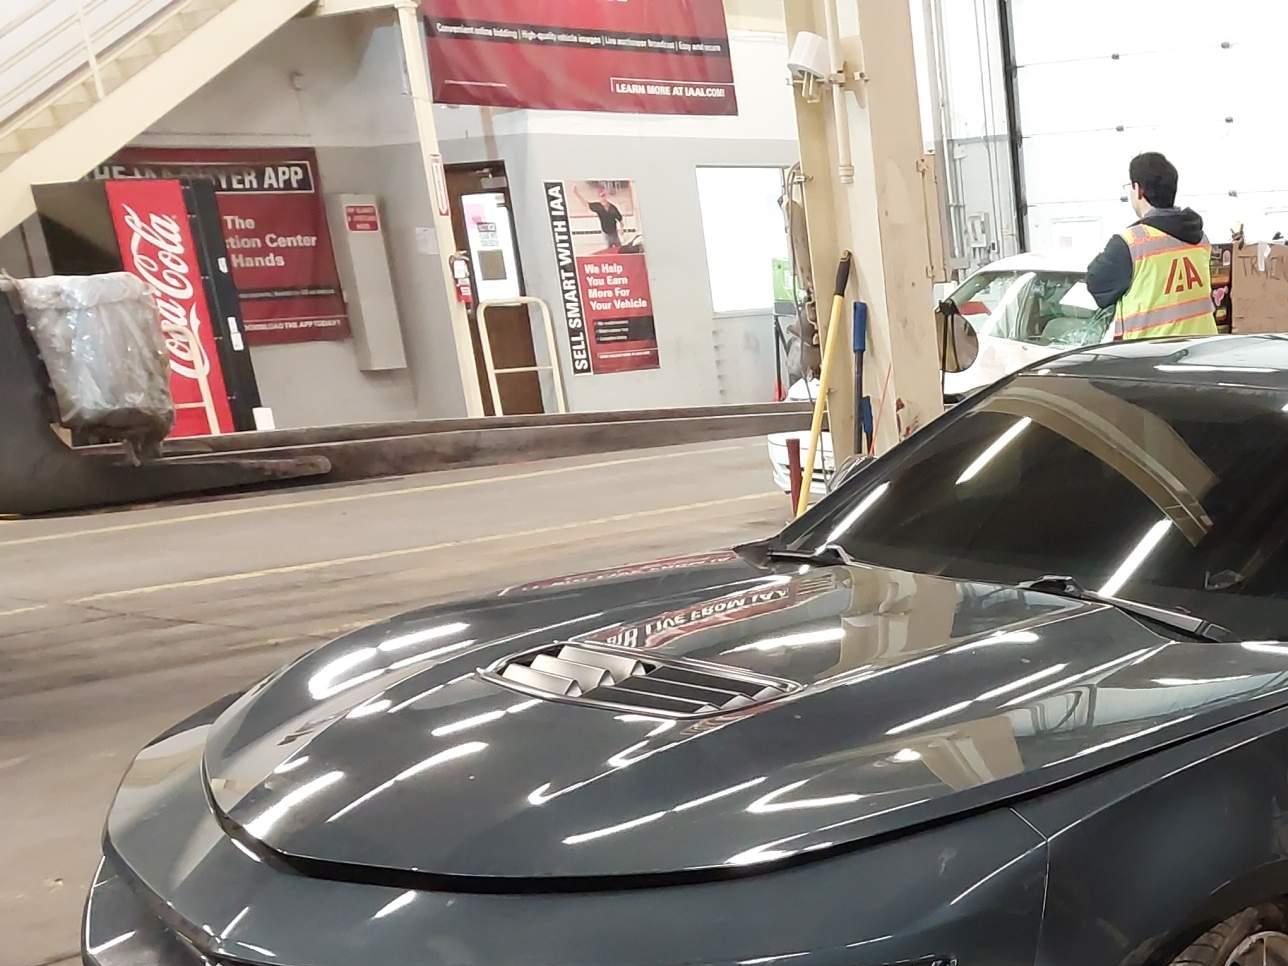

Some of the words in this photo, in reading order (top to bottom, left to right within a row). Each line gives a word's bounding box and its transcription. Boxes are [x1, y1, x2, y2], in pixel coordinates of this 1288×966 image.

[615, 83, 646, 93] LEARN
[646, 85, 671, 96] MORE
[672, 87, 684, 96] AT
[263, 166, 304, 189] APP
[549, 185, 566, 216] IAA
[223, 215, 256, 230] The
[264, 233, 318, 248] Center
[552, 221, 571, 266] WITH
[231, 252, 286, 268] Hands
[584, 263, 600, 274] We
[601, 262, 624, 275] Help
[586, 276, 605, 287] You
[606, 275, 629, 286] Earn
[562, 271, 582, 328] SMART
[588, 288, 614, 299] More
[614, 287, 631, 297] For
[590, 300, 613, 311] Your
[613, 297, 648, 310] Vehicle
[573, 332, 588, 369] SELL
